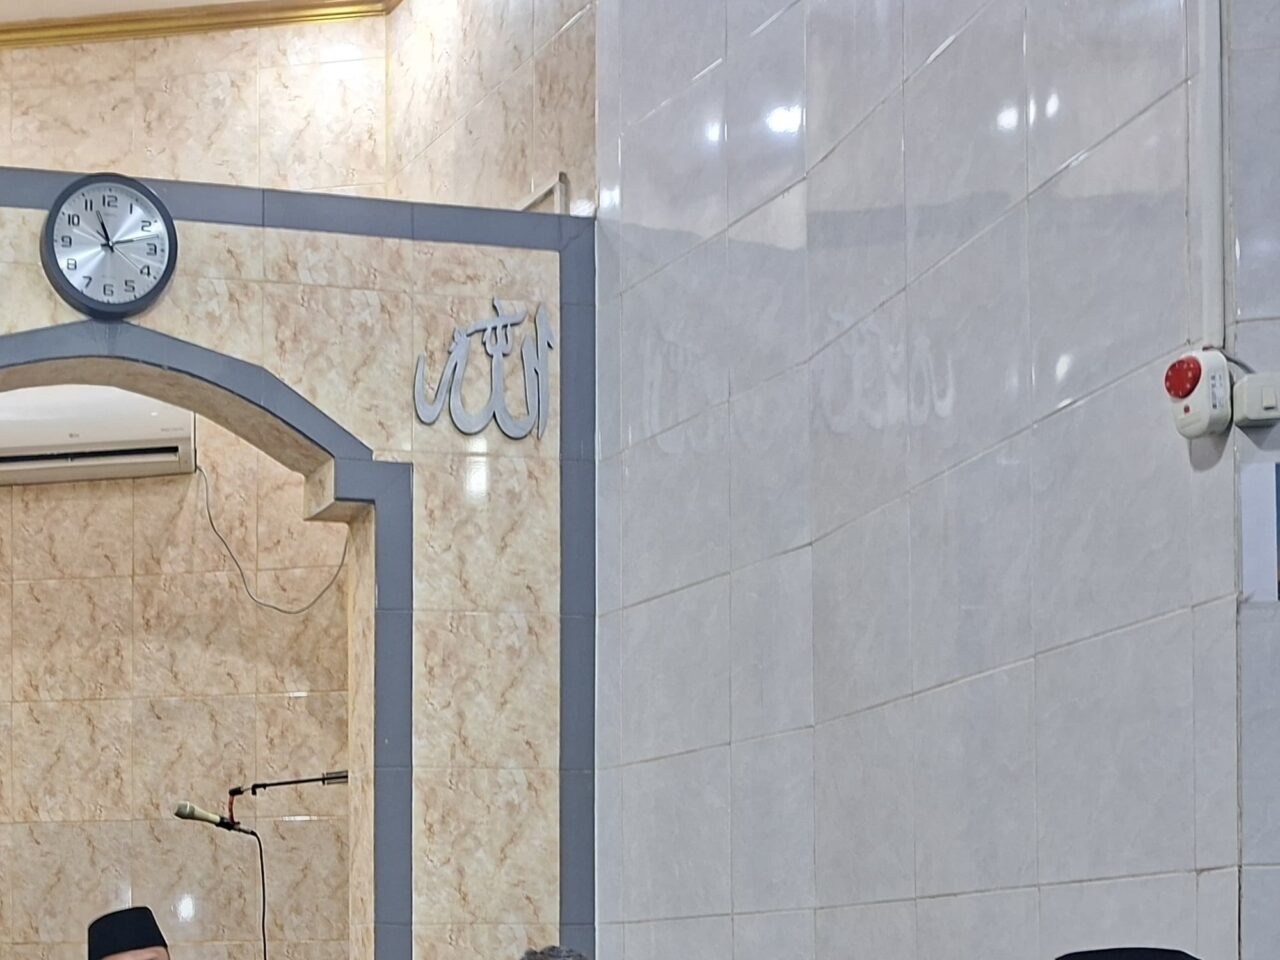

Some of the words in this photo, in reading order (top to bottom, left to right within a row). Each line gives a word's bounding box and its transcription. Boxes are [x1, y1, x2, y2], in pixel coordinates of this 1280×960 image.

[84, 199, 93, 212] 11
[102, 194, 118, 208] 12
[67, 213, 80, 226] 10
[141, 220, 152, 232] 2
[61, 235, 72, 248] 9
[146, 242, 157, 256] 3
[66, 258, 77, 270] 8
[140, 264, 151, 277] 4
[82, 275, 92, 288] 7
[124, 279, 135, 293] 5
[103, 283, 114, 296] 6
